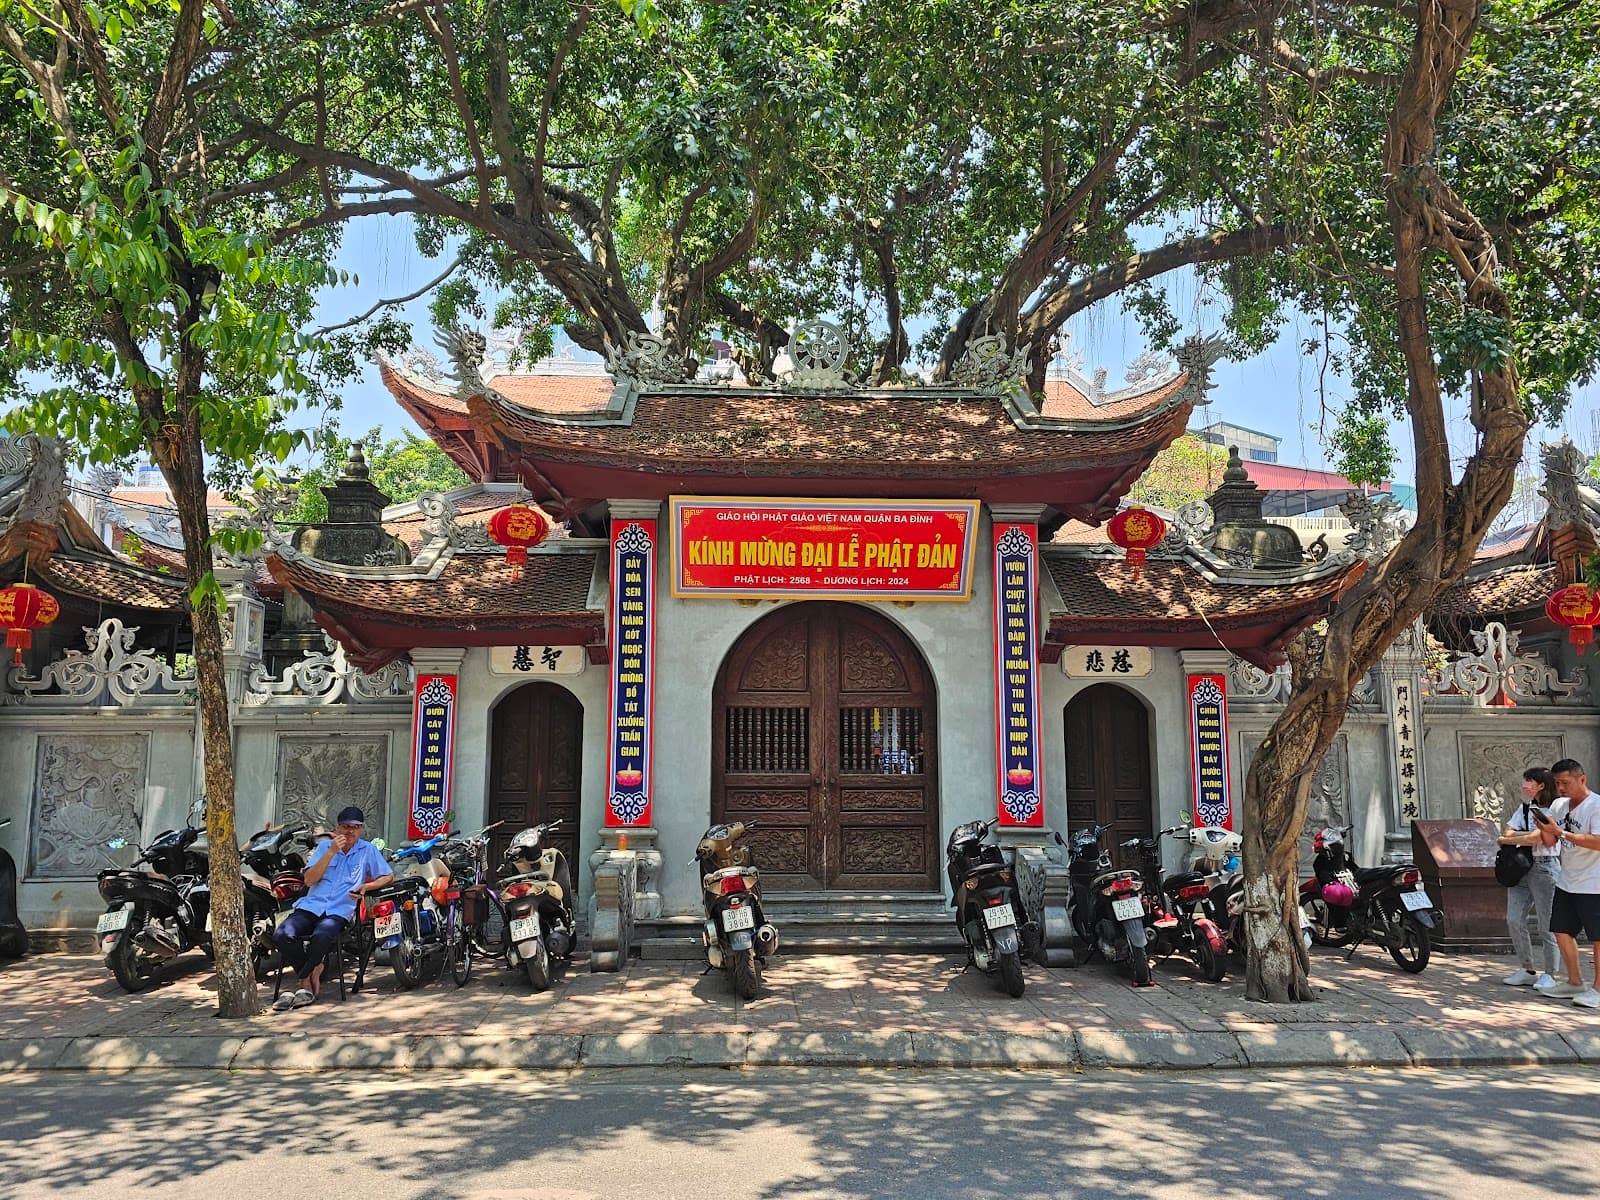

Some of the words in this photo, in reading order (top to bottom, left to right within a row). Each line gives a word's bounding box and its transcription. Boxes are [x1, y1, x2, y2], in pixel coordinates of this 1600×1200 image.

[716, 511, 741, 521] GIÁO
[743, 511, 760, 523] HỘI
[762, 512, 788, 523] PHẬT
[790, 513, 815, 522] GIÁO
[817, 513, 838, 524] VIỆT
[840, 515, 861, 523] NAM
[864, 514, 891, 525] QUẬN
[894, 515, 908, 523] BA
[909, 514, 933, 524] ĐÌNH
[688, 535, 735, 566] KÍNH
[740, 535, 796, 567] MỪNG
[801, 542, 833, 573] ĐẠI
[838, 533, 860, 568] LỄ
[864, 538, 914, 574] PHẬT
[917, 533, 957, 569] ĐẢN
[625, 556, 641, 569] BẢY
[1004, 560, 1026, 572] VƯỜN
[625, 571, 642, 583] ĐÓA
[733, 575, 761, 585] PHẬT
[762, 576, 788, 585] LỊCH:
[789, 576, 811, 585] 2568
[823, 576, 859, 586] DƯƠNG
[861, 577, 886, 587] LỊCH:
[887, 577, 909, 586] 2024
[1007, 574, 1024, 586] LÂM
[625, 587, 641, 597] SEN
[1005, 589, 1026, 600] CHỢT
[622, 600, 643, 611] VÀNG
[1006, 599, 1026, 614] THẤY
[1008, 617, 1025, 628] HOA
[625, 628, 640, 640] GÓT
[621, 644, 643, 656] NGỌC
[1011, 643, 1023, 656] NỞ
[623, 656, 641, 669] ĐÓN
[1005, 658, 1029, 670] MUÔN
[620, 671, 644, 683] MỪNG
[1009, 674, 1026, 686] VẠN
[1011, 688, 1025, 699] TIN
[425, 706, 445, 716] DƯỚI
[624, 700, 639, 712] TÁT
[1011, 702, 1025, 713] VUI
[1199, 706, 1218, 715] CHÍN
[426, 719, 443, 729] CÂY
[617, 713, 645, 727] XUỐNG
[428, 731, 440, 741] VÔ
[1009, 731, 1029, 743] NHỊP
[1199, 731, 1220, 739] PHUN
[620, 746, 640, 757] GIAN
[1011, 744, 1028, 756] ĐÀN
[1200, 743, 1221, 751] NƯỚC
[424, 755, 441, 766] ĐẢN
[422, 770, 442, 779] SINH
[1201, 766, 1222, 776] BƯỚC
[425, 783, 438, 793] THỊ
[1202, 780, 1223, 788] XƯNG
[421, 795, 440, 805] HIỆN
[1205, 791, 1220, 801] TÔN
